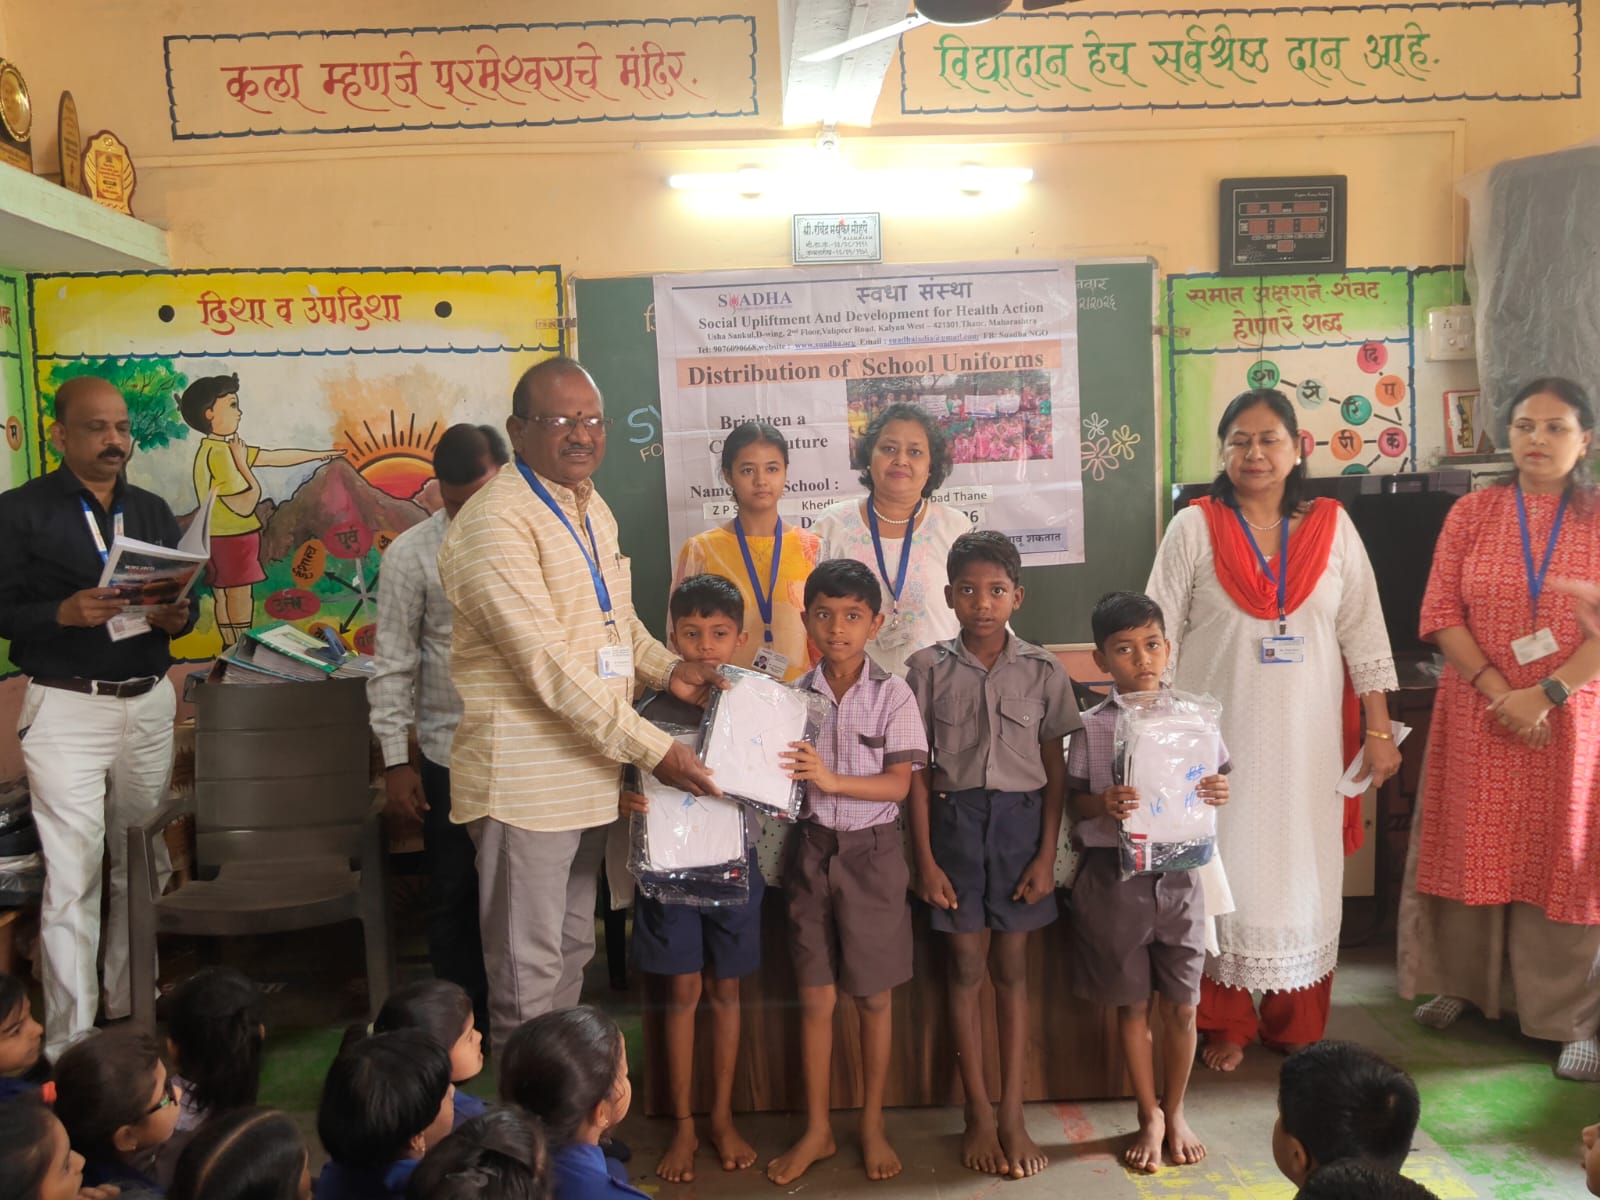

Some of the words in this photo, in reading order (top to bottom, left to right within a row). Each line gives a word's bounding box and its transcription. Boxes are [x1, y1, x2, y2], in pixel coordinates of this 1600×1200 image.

[933, 34, 1092, 97] विद्यादान
[1082, 30, 1148, 88] हेच
[1148, 24, 1269, 88] सर्वश्रेष्ठ
[1285, 37, 1366, 88] दान
[220, 64, 327, 114] कला
[320, 51, 446, 112] म्हणजे
[431, 42, 620, 105] परमेश्वराचे
[856, 285, 908, 304] स्वधा
[919, 277, 973, 300] संस्था
[1186, 287, 1244, 310] समान
[197, 290, 274, 335] दिशा
[274, 298, 294, 324] व
[302, 286, 402, 331] उपदिशा
[699, 317, 737, 330] Social
[742, 314, 810, 330] Upliftment
[814, 311, 841, 324] And
[846, 308, 928, 323] Development
[934, 306, 952, 317] for
[956, 304, 998, 316] Health
[1002, 302, 1044, 314] Action
[1302, 312, 1352, 339] शब्द
[688, 362, 821, 385] Distribution
[828, 358, 851, 378] of
[862, 355, 935, 377] School
[942, 351, 1044, 372] Uniforms
[797, 415, 806, 424] a
[787, 437, 829, 450] uture
[784, 478, 830, 492] School
[953, 491, 987, 501] Thane
